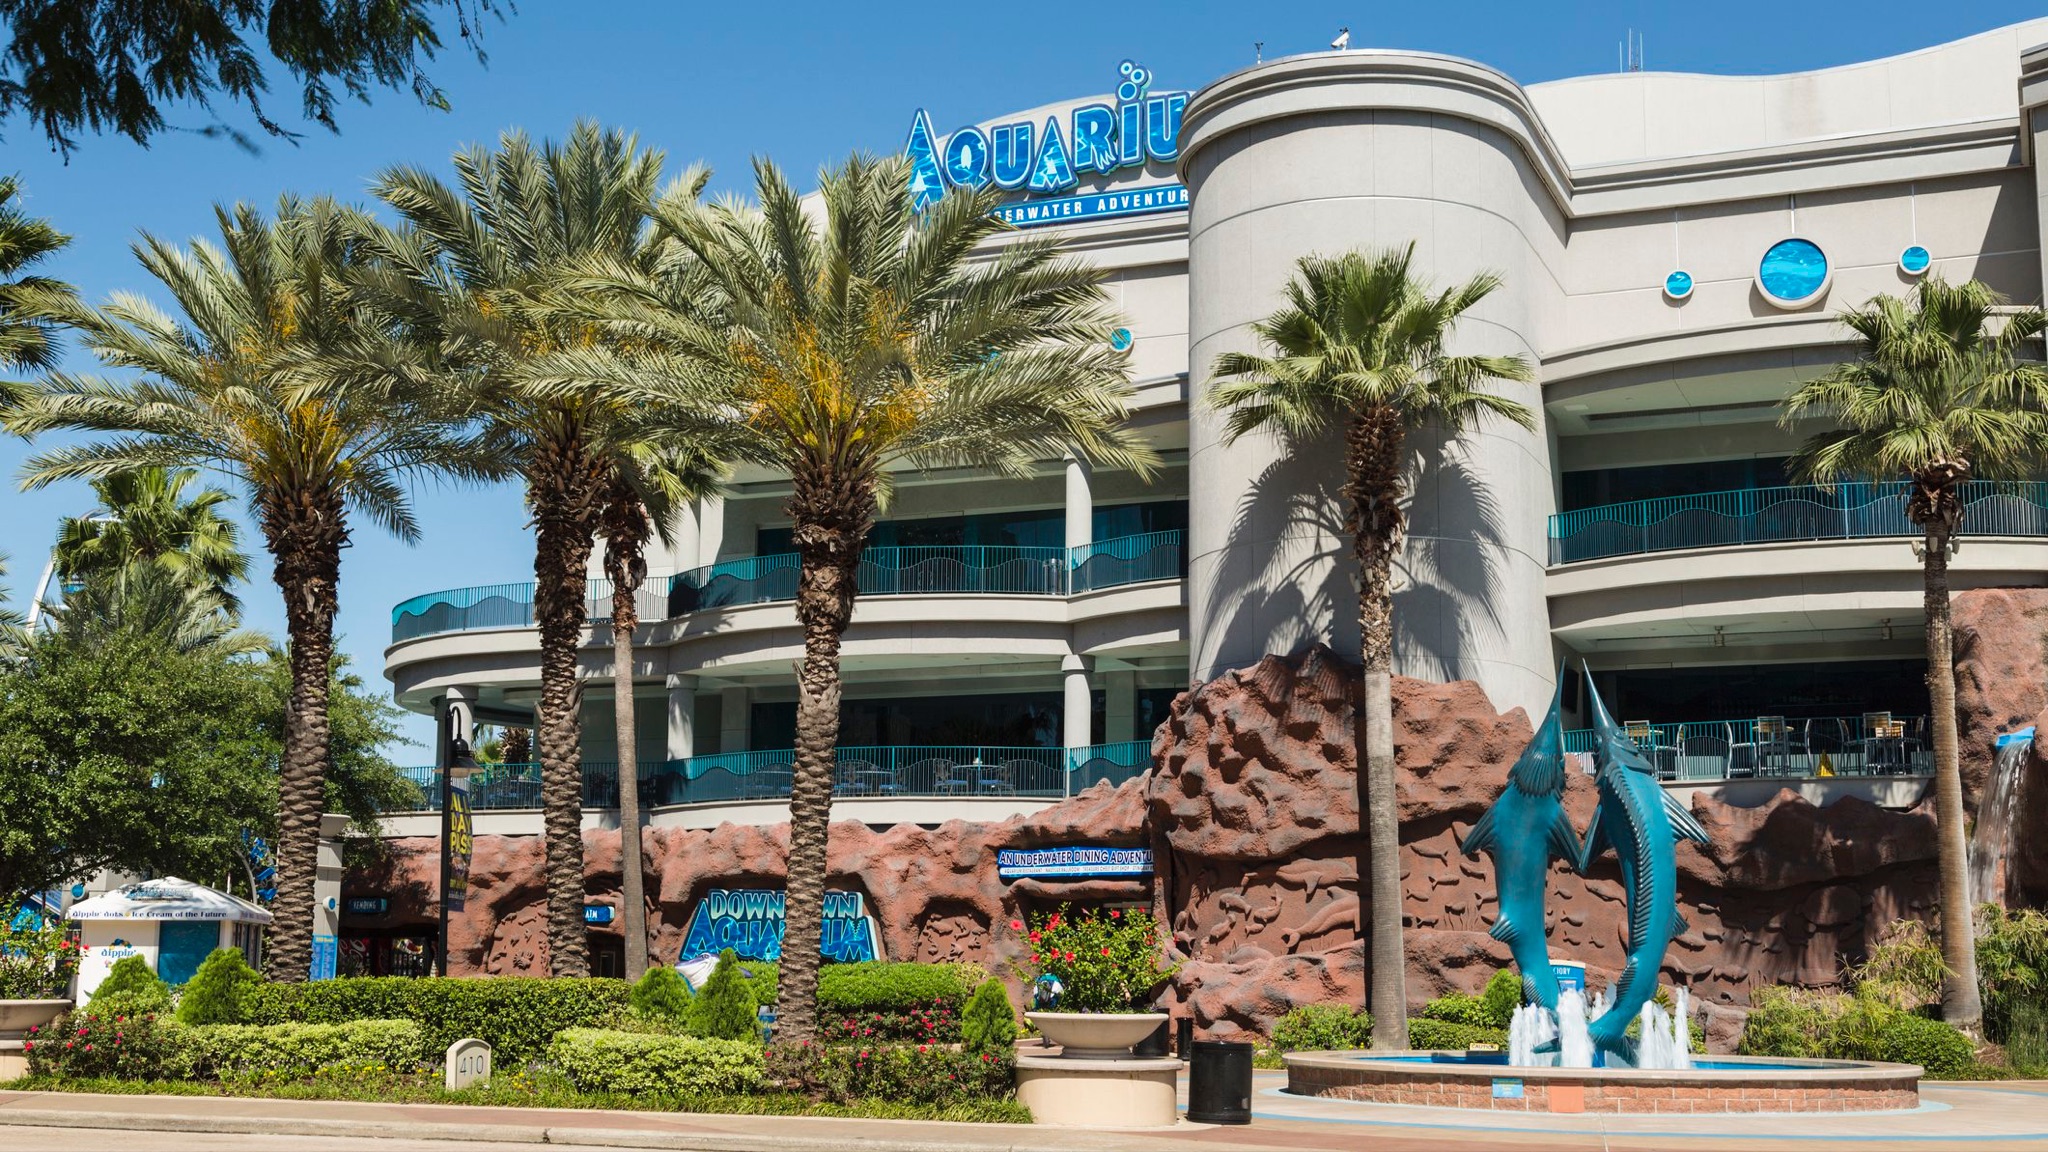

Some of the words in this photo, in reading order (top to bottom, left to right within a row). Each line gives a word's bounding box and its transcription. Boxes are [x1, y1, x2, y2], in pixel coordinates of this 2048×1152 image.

[902, 78, 1188, 214] AQUARIU
[990, 201, 1082, 223] DERWATER
[1098, 190, 1189, 212] ADVENTUR
[450, 792, 472, 815] ALL
[451, 812, 472, 834] DAY
[450, 832, 473, 854] PASS
[1000, 851, 1014, 865] AN
[1014, 850, 1073, 866] UNDERWATER
[1074, 850, 1109, 863] DINING
[1109, 850, 1154, 864] ADVENTU
[585, 909, 598, 919] ATM
[710, 891, 857, 920] DOWNWN
[682, 900, 872, 963] AQUAUM
[1553, 966, 1571, 976] CTORY
[460, 1055, 484, 1076] 410
